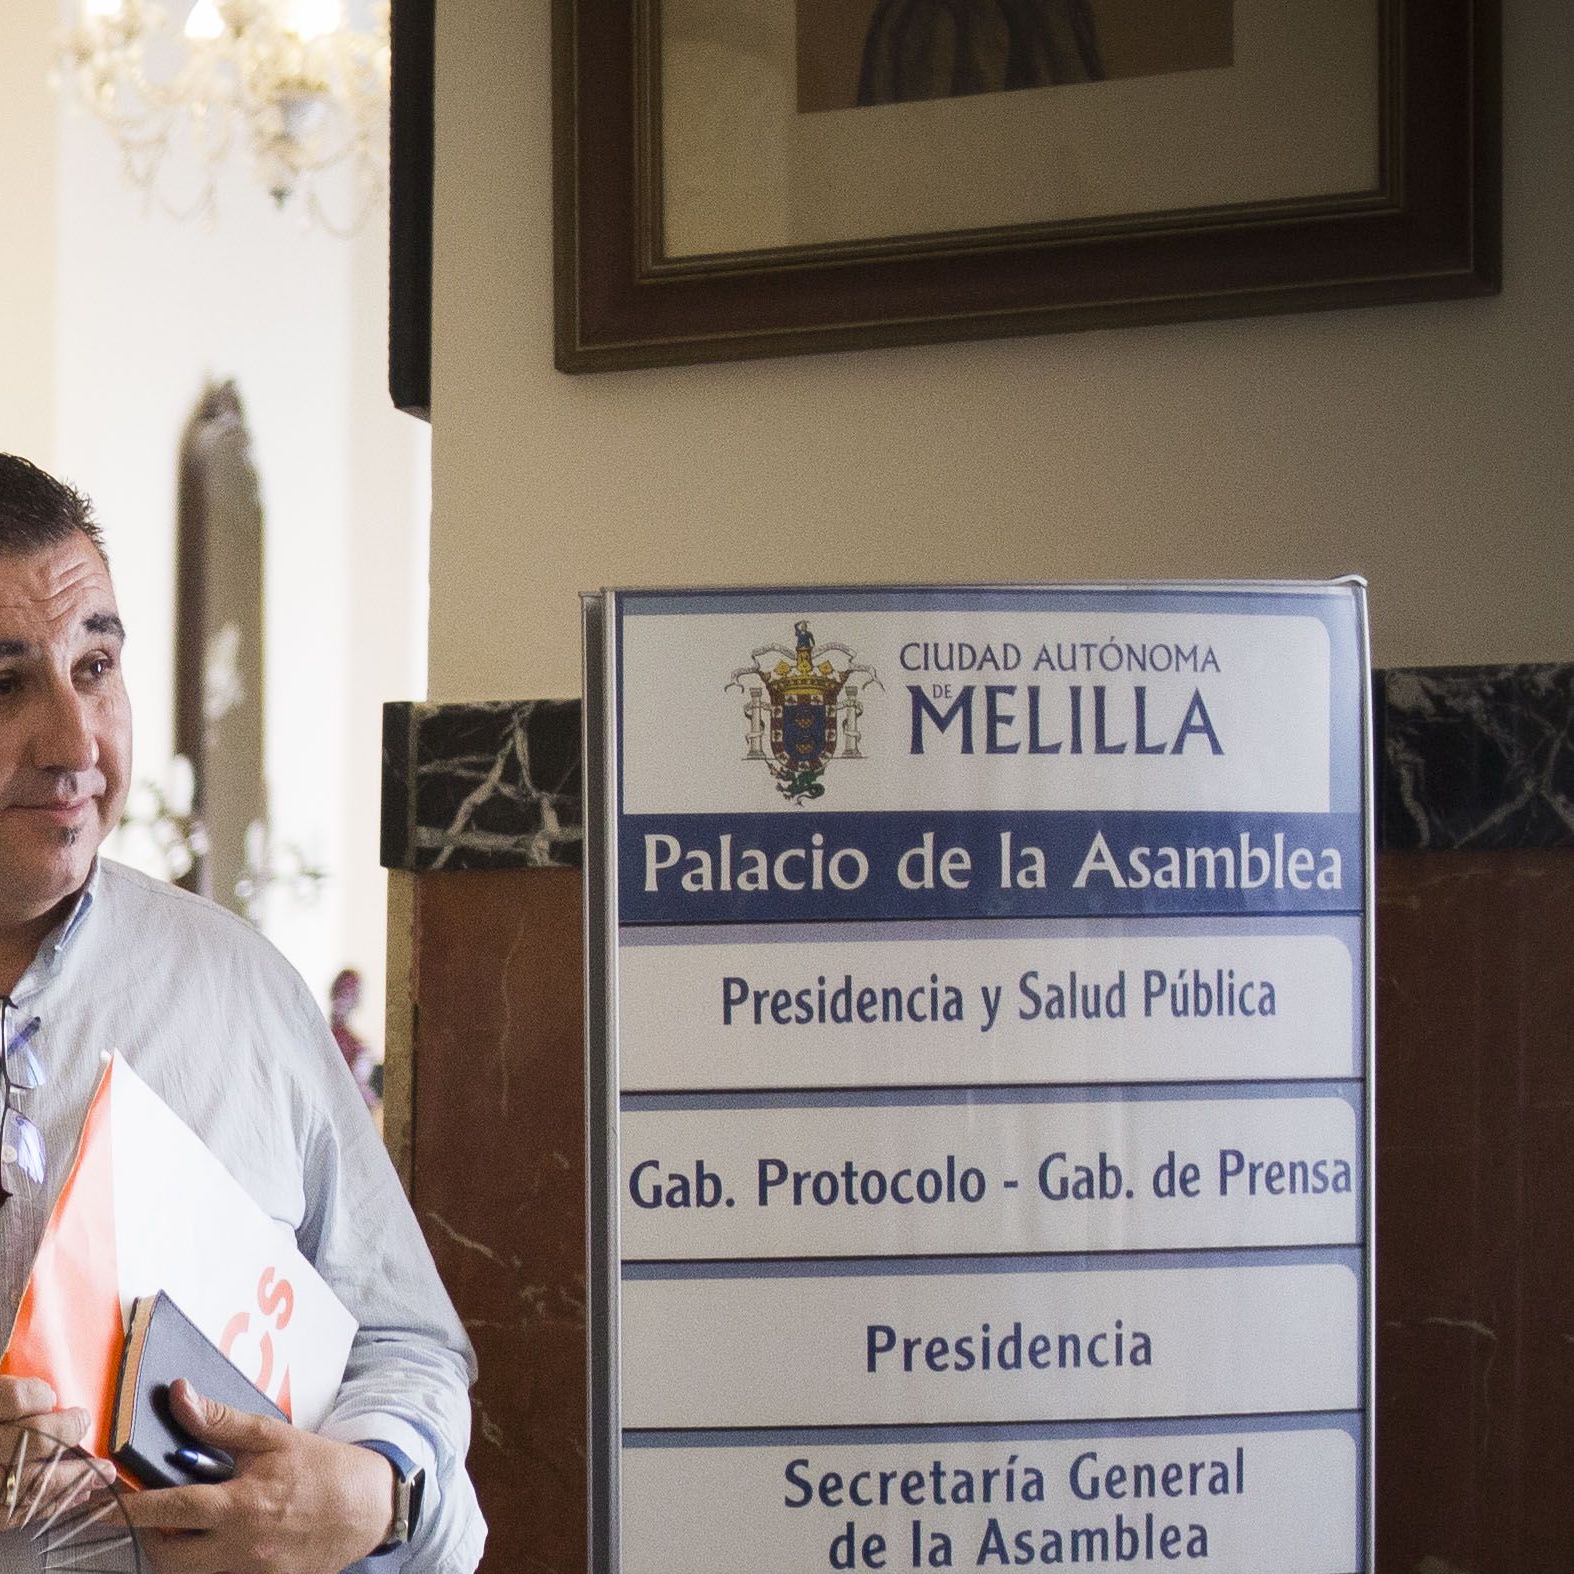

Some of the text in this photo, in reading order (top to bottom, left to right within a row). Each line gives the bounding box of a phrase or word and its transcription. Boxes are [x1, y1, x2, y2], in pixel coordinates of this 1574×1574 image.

[899, 635, 1220, 673] CIUDAD AUTÓNOMA
[906, 684, 1223, 756] MELILLA
[932, 683, 954, 700] DE
[644, 829, 1344, 892] Palacio de la Asamblea
[722, 969, 1276, 1033] Presidencia y Salud Pública
[629, 1149, 1351, 1209] Gab. Protocolo - Gab. de Prensa
[866, 1319, 1152, 1373] Presidencia
[784, 1447, 1244, 1509] Secretaría General
[829, 1512, 1208, 1570] de la Asamblea
